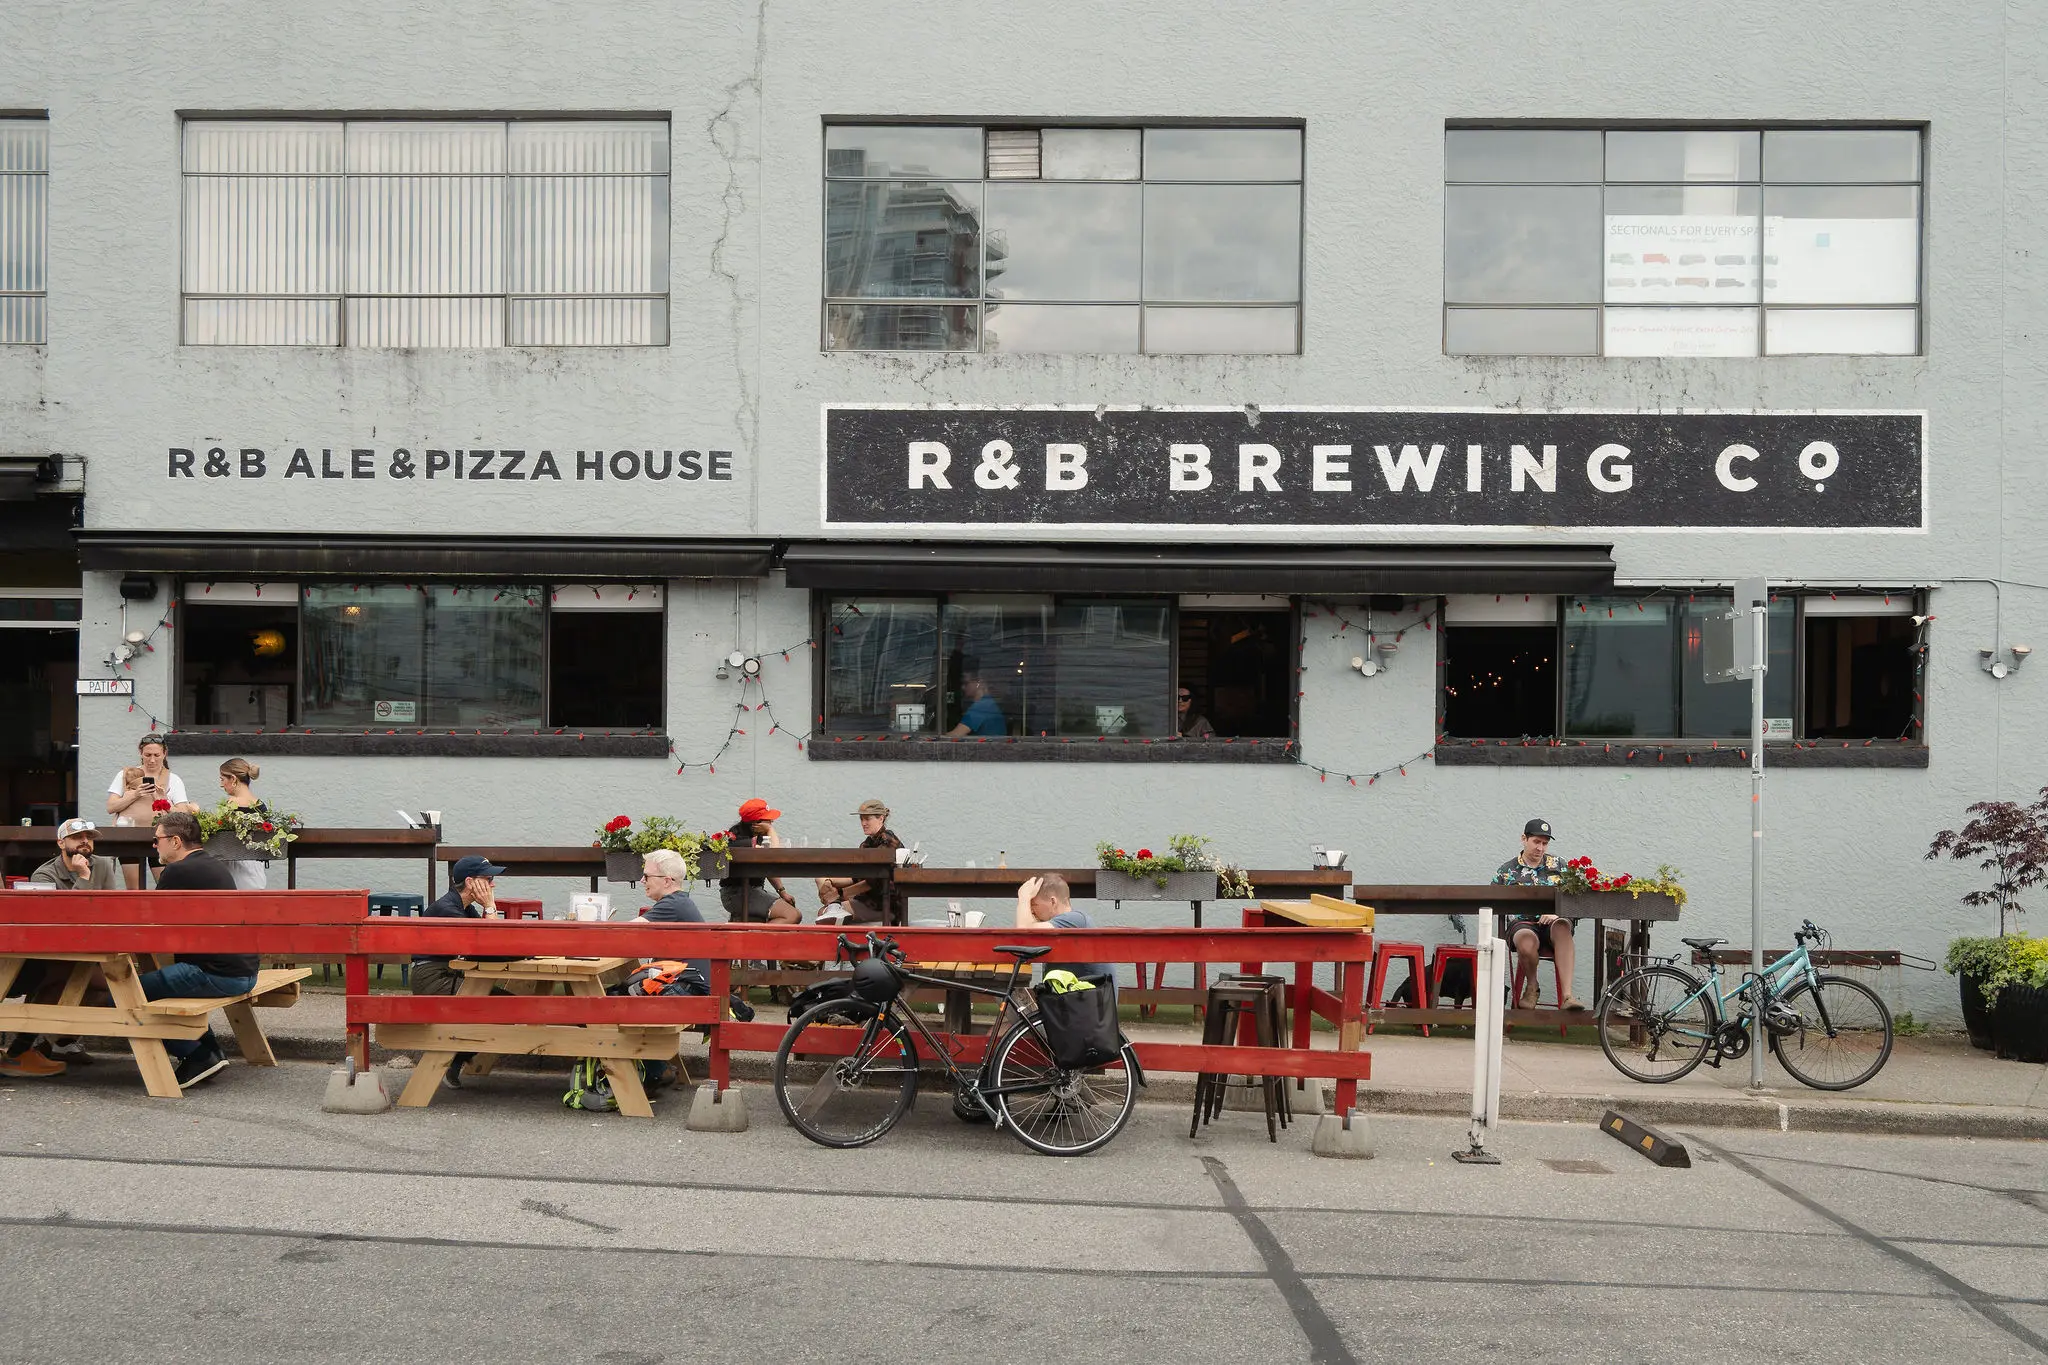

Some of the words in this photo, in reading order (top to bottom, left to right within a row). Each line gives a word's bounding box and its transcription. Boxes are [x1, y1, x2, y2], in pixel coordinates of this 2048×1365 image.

[1610, 225, 1678, 236] SECTIONALS
[1680, 225, 1702, 236] FOR
[1704, 225, 1737, 237] EVERY
[168, 447, 267, 479] R&B
[284, 447, 376, 480] ALE
[576, 450, 733, 481] HOUSE
[907, 439, 1089, 491] R&B
[1168, 443, 1633, 493] BREWING
[90, 681, 118, 693] PATIO
